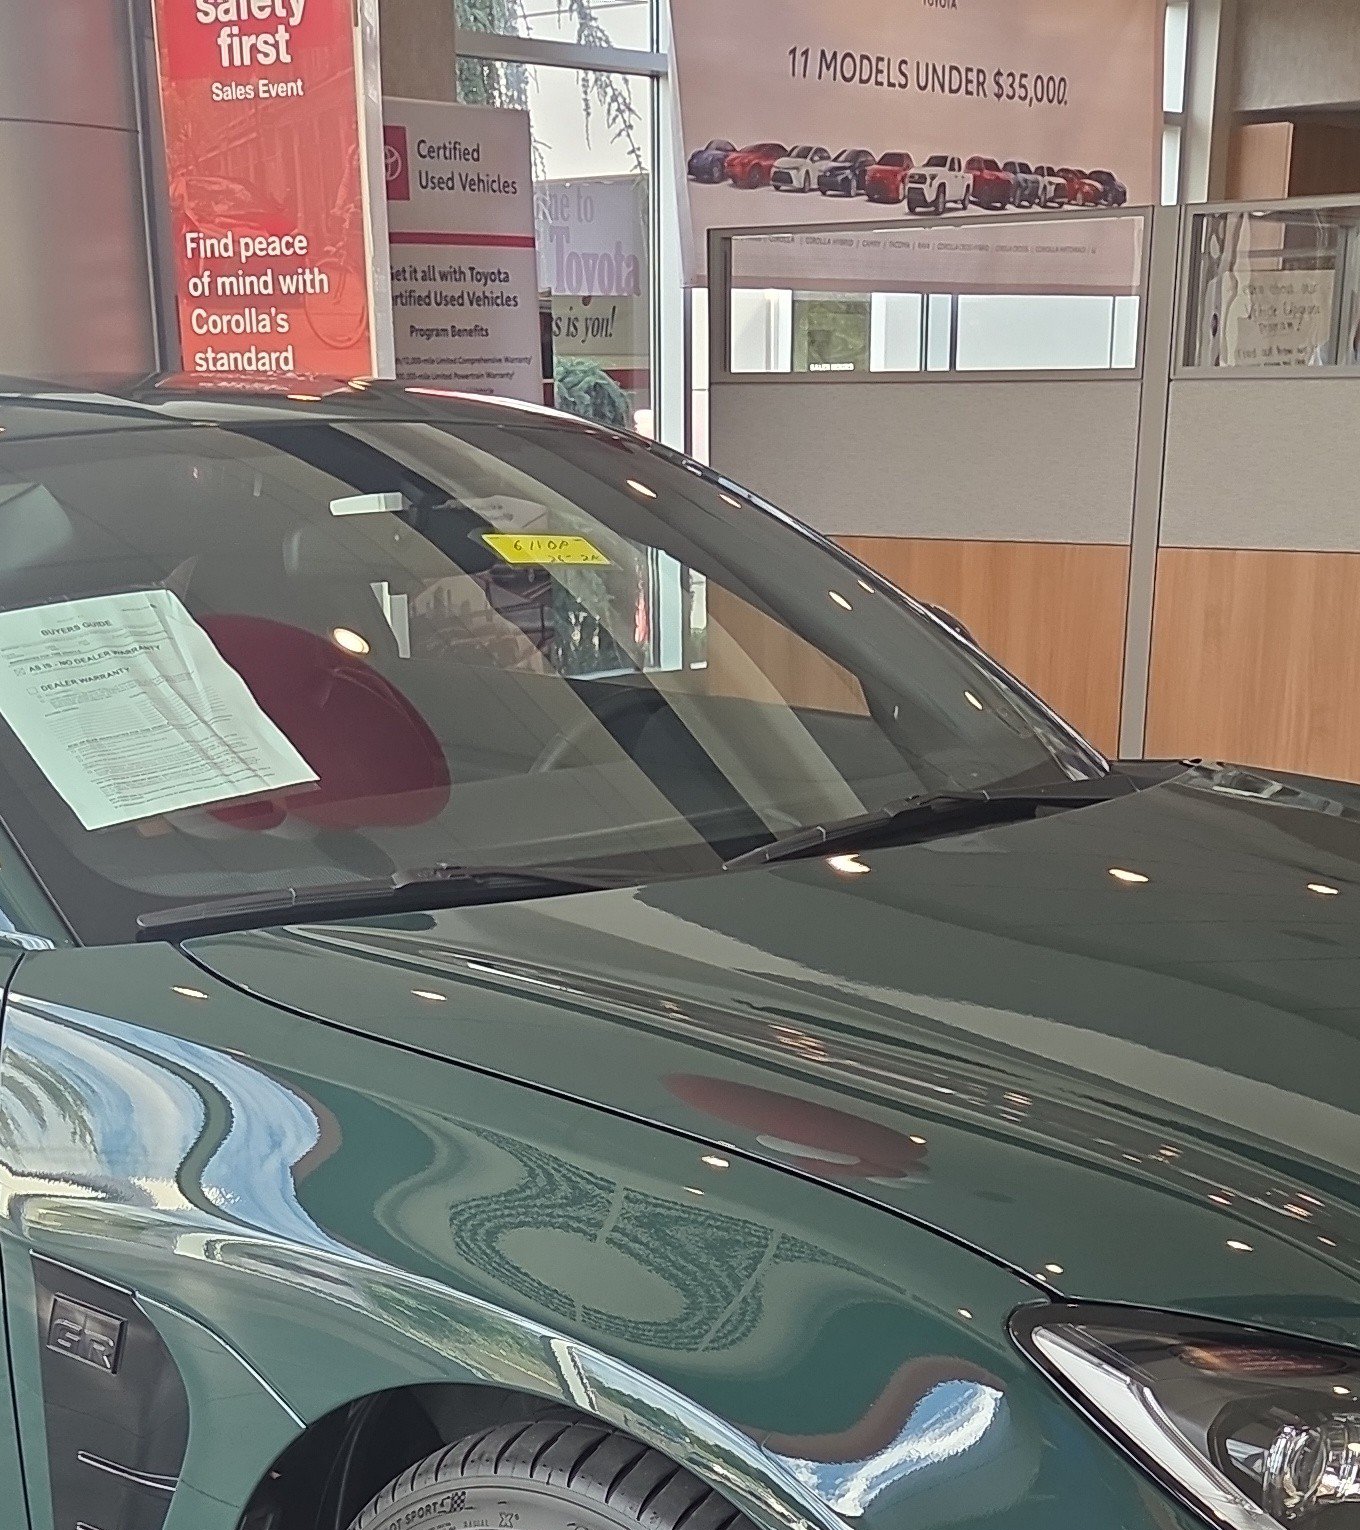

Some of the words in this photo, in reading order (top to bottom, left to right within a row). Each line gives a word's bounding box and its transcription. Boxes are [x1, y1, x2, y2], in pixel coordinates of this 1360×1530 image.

[217, 24, 292, 67] first
[211, 81, 255, 101] Sales
[258, 77, 305, 98] Event
[788, 46, 810, 78] 11
[817, 48, 909, 90] MODELS
[915, 60, 988, 98] UNDER
[993, 67, 1068, 107] $35,000.
[417, 139, 481, 163] Certified
[419, 170, 455, 191] Used
[458, 171, 518, 195] Vehicles
[185, 230, 234, 259] Find
[240, 234, 308, 264] peace
[188, 270, 211, 297] of
[216, 268, 274, 297] mind
[278, 266, 330, 295] with
[409, 265, 418, 282] it
[421, 265, 436, 282] all
[438, 265, 466, 282] with
[468, 266, 510, 287] Toyota
[434, 290, 465, 307] Used
[466, 291, 519, 308] Vehicles
[191, 307, 289, 335] Corolla's
[409, 324, 449, 340] Program
[451, 324, 489, 338] Benefits
[566, 306, 579, 338] is
[581, 305, 616, 343] you!
[194, 345, 294, 372] standard
[83, 619, 112, 629] GUIDE
[74, 650, 112, 665] DEALER
[40, 677, 80, 692] DEALER
[80, 666, 131, 684] WARRANTY
[405, 1501, 438, 1526] SPORT
